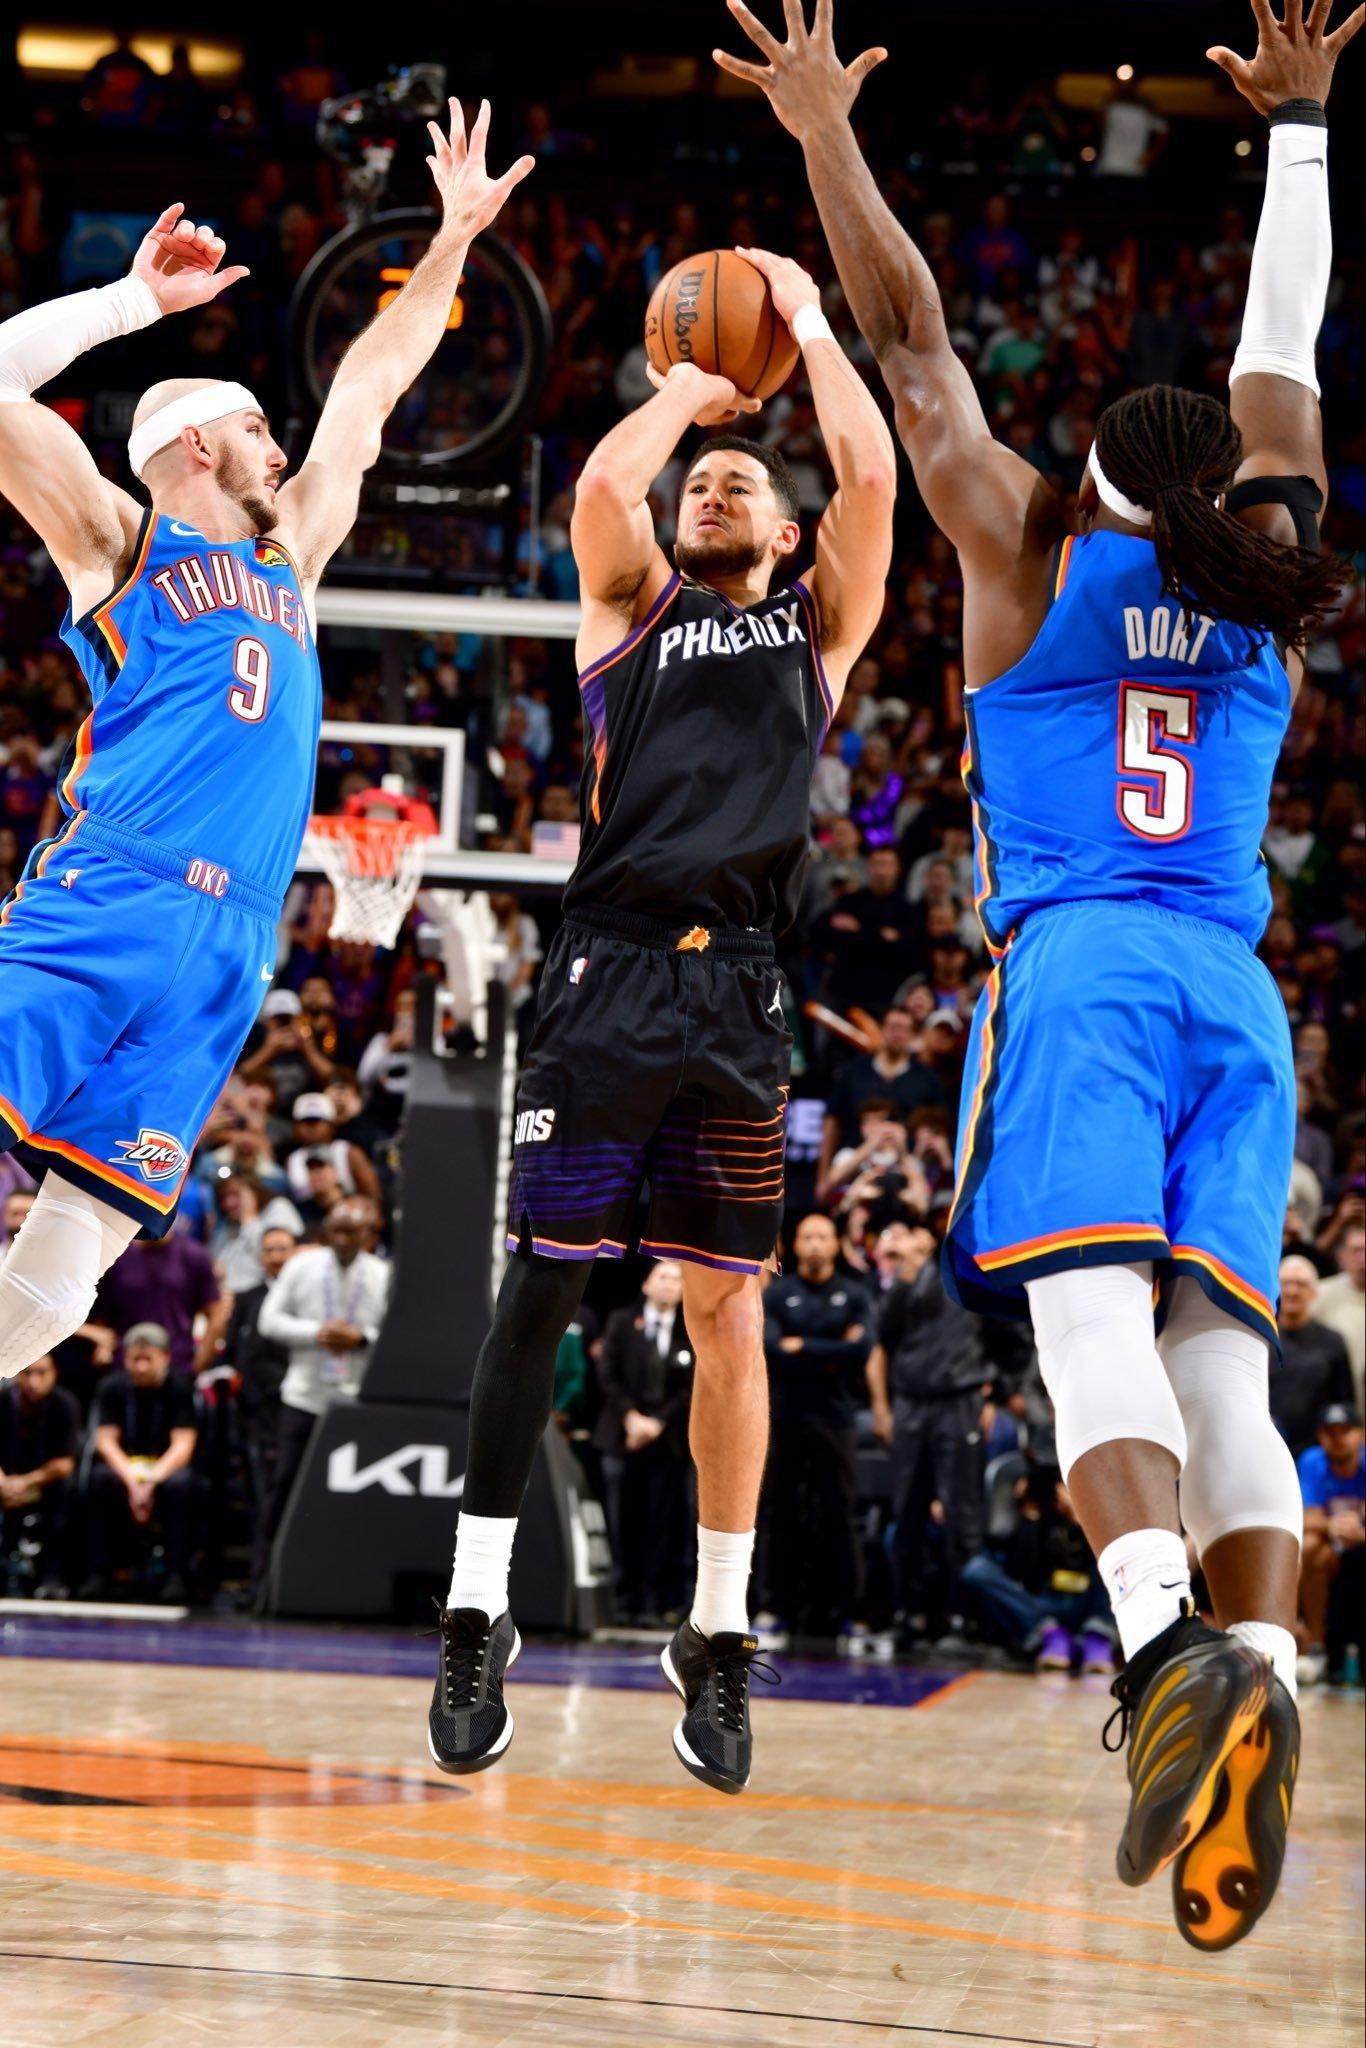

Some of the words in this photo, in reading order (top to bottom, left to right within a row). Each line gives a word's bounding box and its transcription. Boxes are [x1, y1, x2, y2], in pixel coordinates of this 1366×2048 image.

[152, 551, 309, 655] THUNDER
[658, 602, 806, 670] PHOENIX
[1123, 606, 1216, 665] DORT
[227, 634, 271, 724] 9
[1116, 680, 1198, 843] 5
[184, 858, 230, 900] OKC
[127, 1143, 179, 1163] OKC
[327, 1440, 466, 1498] KI
